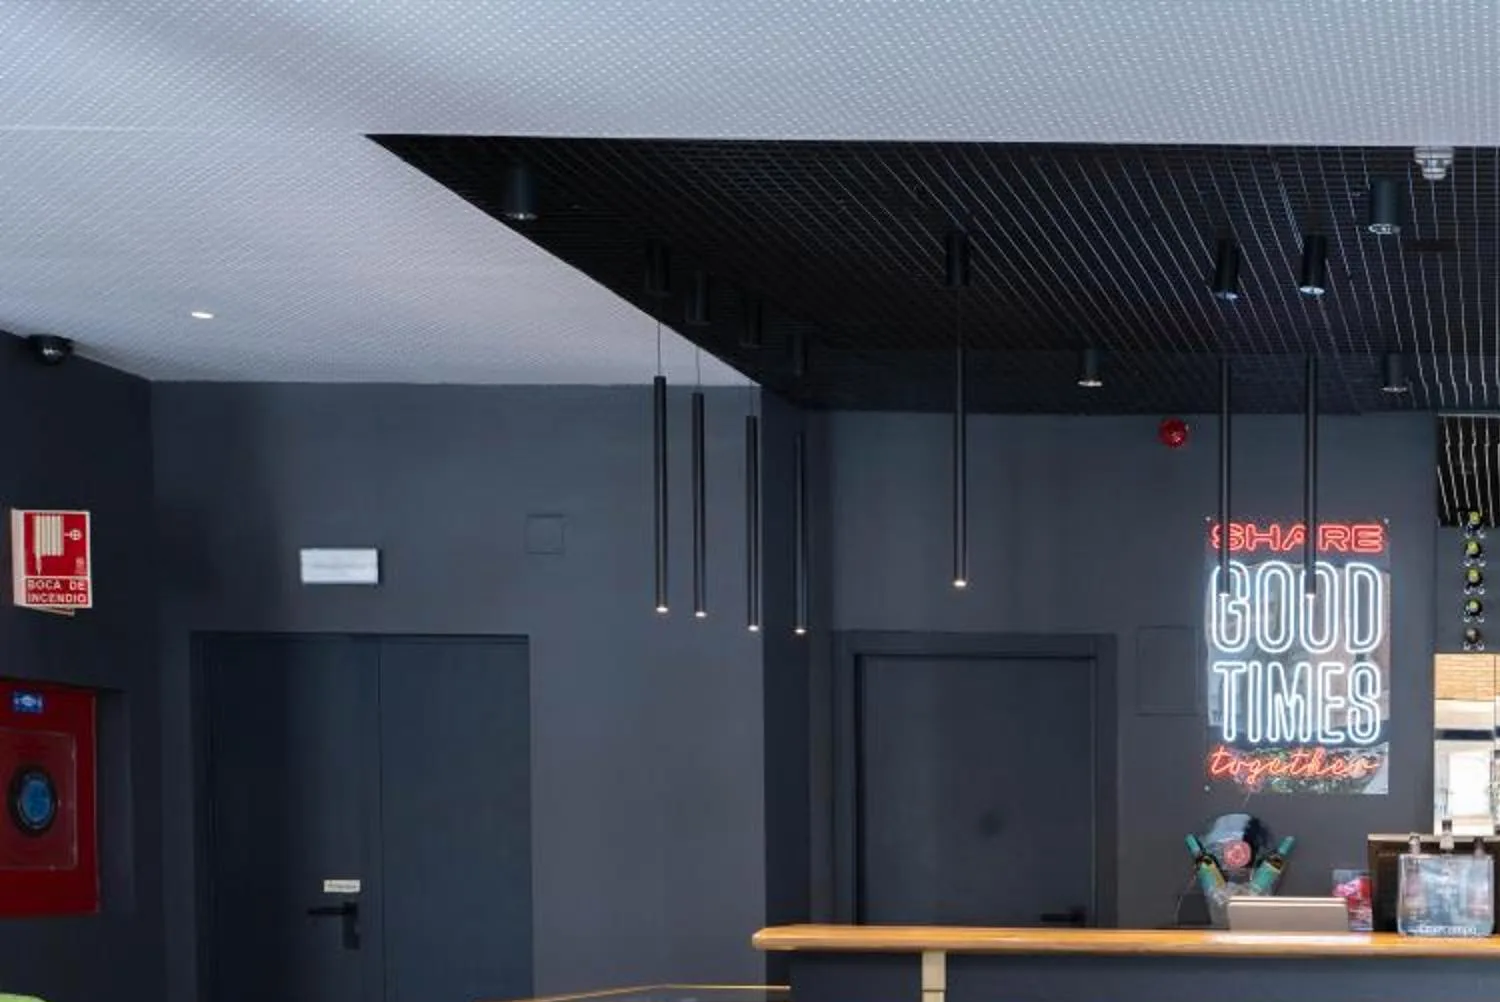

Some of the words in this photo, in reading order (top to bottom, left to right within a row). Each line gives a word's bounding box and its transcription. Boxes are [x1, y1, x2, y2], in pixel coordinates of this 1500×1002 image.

[1211, 523, 1384, 553] SHARE
[27, 580, 61, 590] BOCA
[69, 581, 86, 591] DE
[28, 593, 87, 604] INCENDIO
[1211, 560, 1383, 654] GOOD
[1212, 661, 1381, 744] TIMES
[1209, 747, 1378, 784] together
